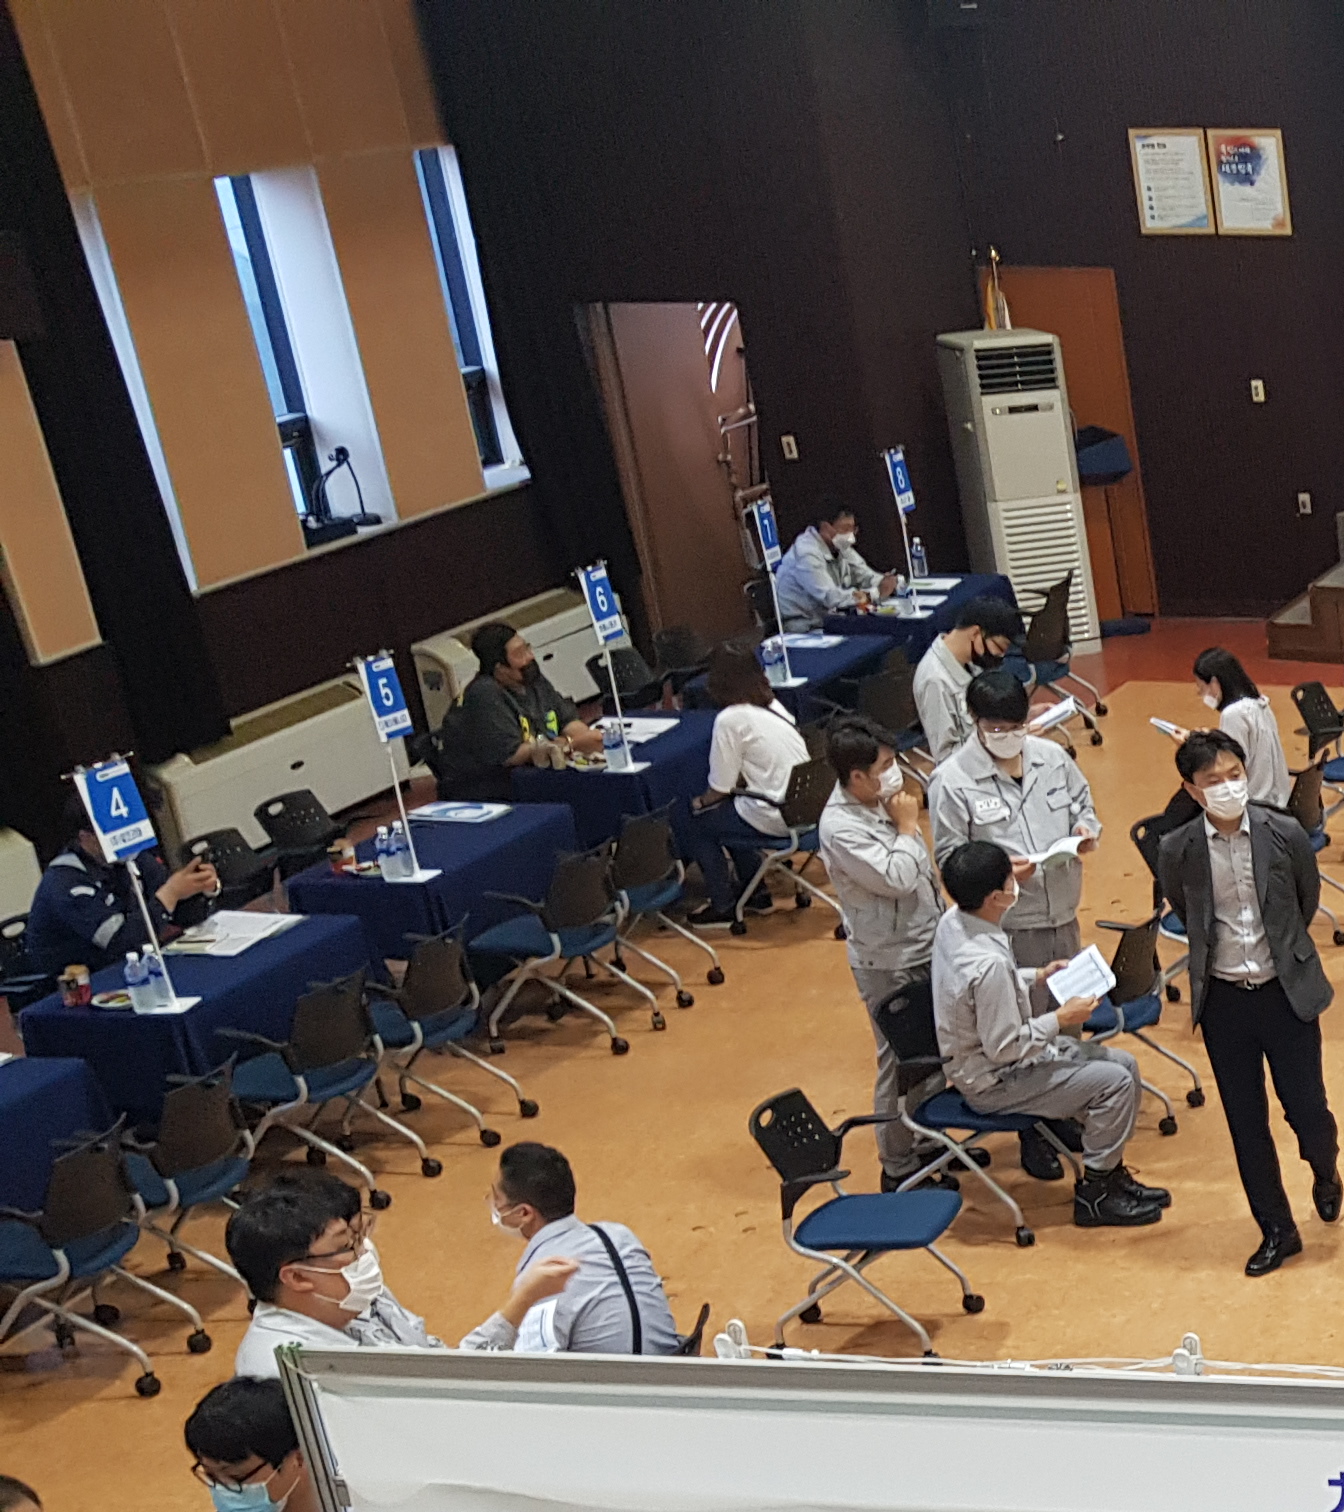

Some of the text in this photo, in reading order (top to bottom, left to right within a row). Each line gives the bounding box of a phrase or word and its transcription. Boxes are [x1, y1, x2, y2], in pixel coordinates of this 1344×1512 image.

[896, 470, 905, 489] 8
[595, 586, 609, 613] 6
[379, 676, 396, 707] 5
[108, 785, 130, 820] 4
